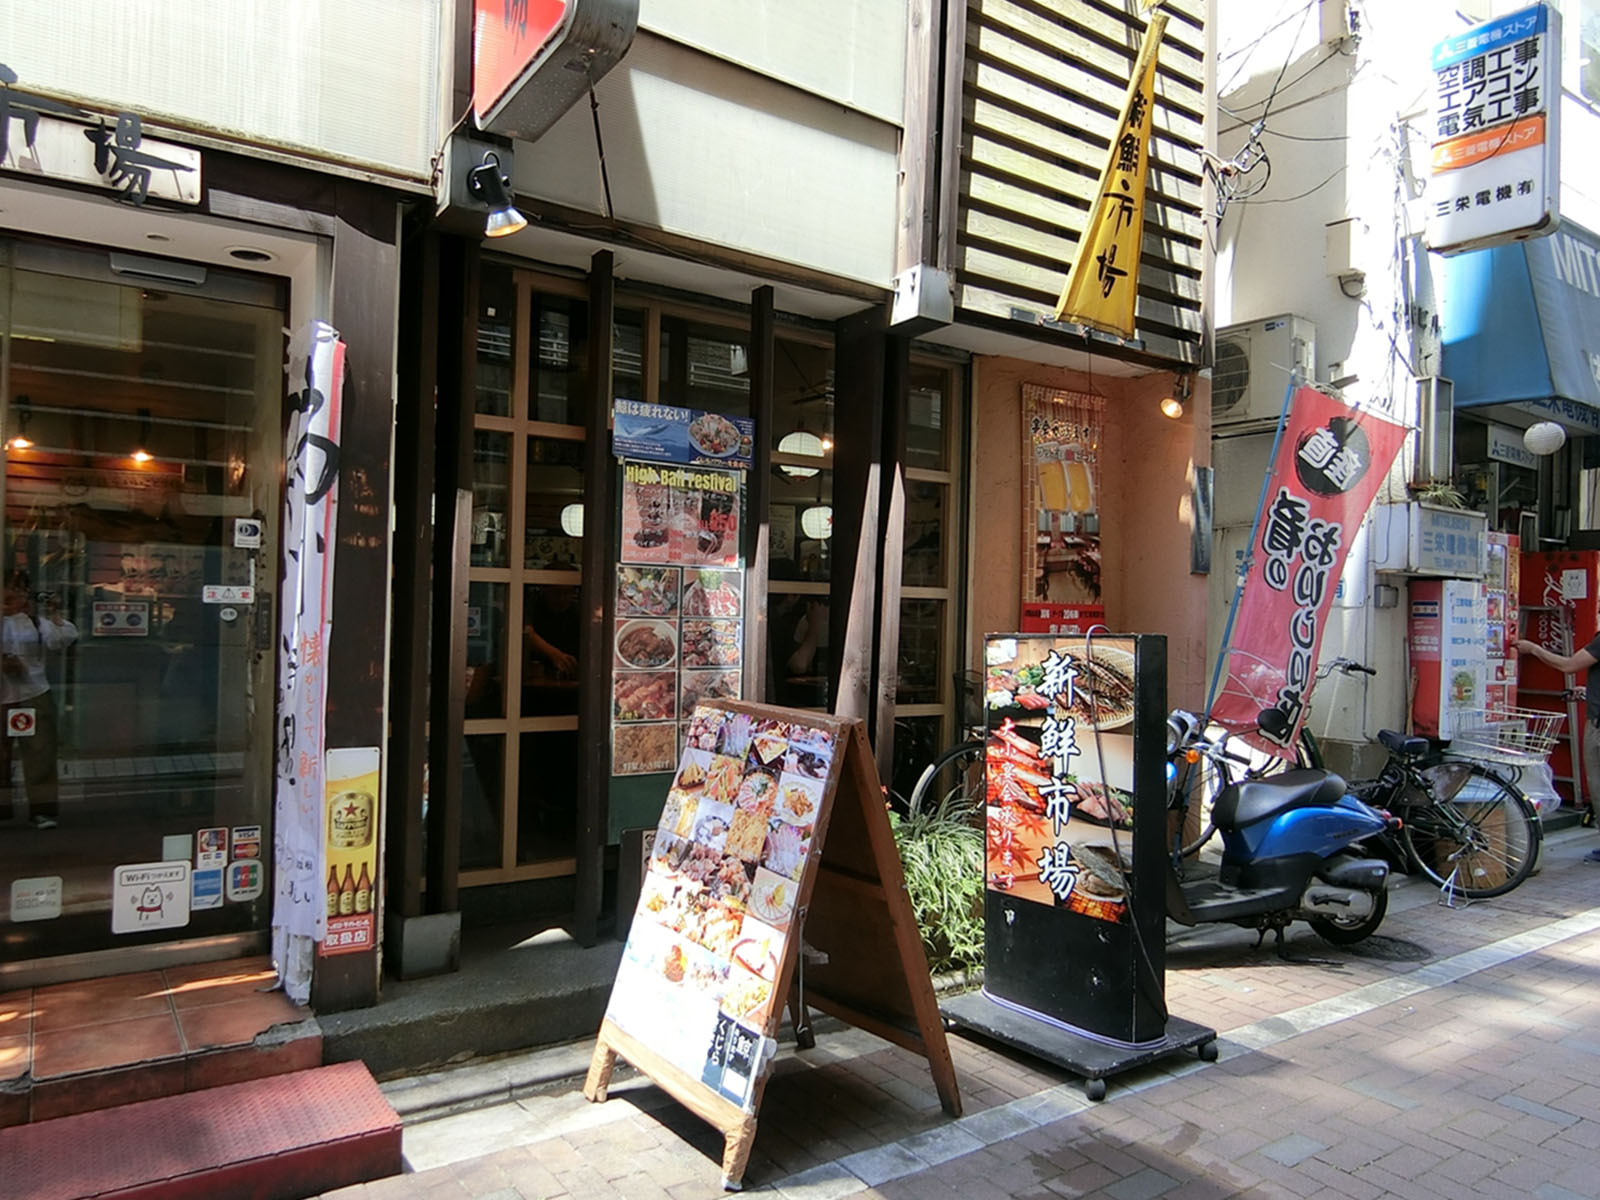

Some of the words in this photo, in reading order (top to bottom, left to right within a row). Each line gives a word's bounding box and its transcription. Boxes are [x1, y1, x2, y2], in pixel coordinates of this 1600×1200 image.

[1437, 37, 1540, 91] 空調工事
[1437, 67, 1539, 114] エアコン
[1437, 86, 1540, 137] 電気工事
[660, 469, 685, 487] Ball
[1037, 650, 1081, 900] 新鮮市場
[326, 930, 367, 946] 取扱店
[712, 1020, 727, 1067] くじら
